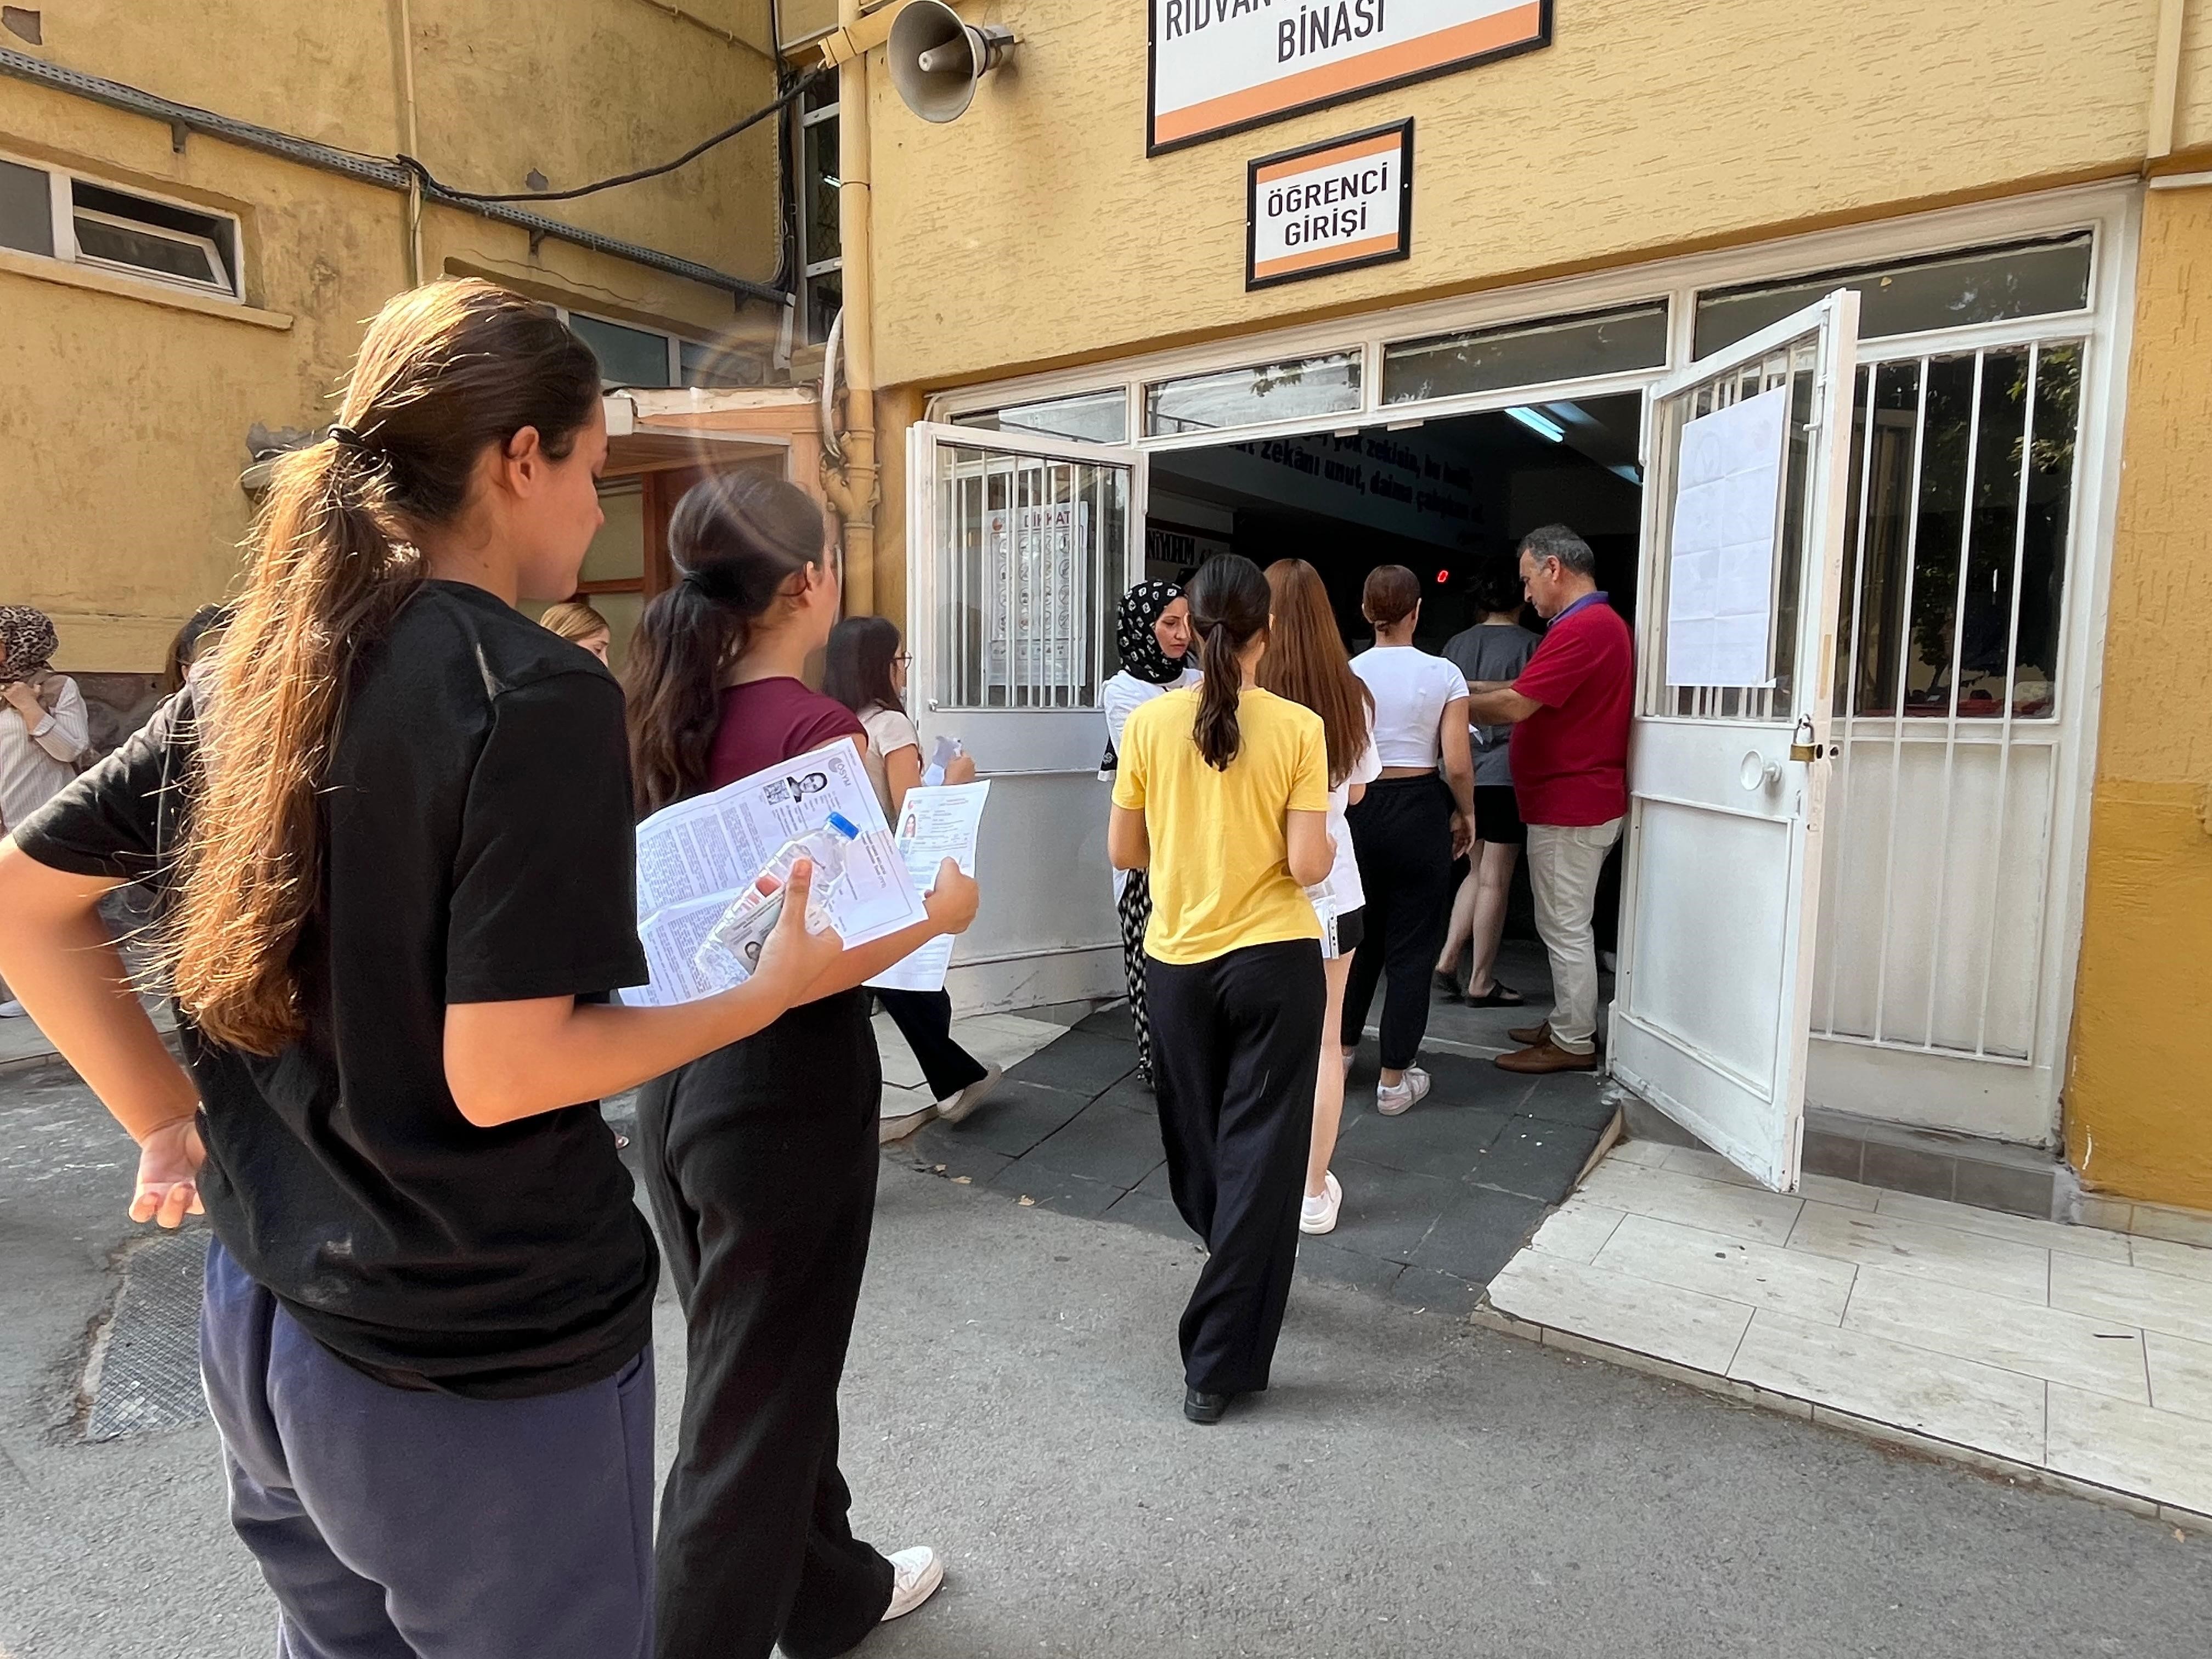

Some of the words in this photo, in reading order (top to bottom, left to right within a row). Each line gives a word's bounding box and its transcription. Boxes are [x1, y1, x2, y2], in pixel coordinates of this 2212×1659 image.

[1166, 0, 1271, 41] RIDV
[1278, 0, 1385, 63] BİNASI
[1268, 161, 1387, 217] ÖĞRENCİ
[1285, 201, 1367, 246] GİRİŞİ
